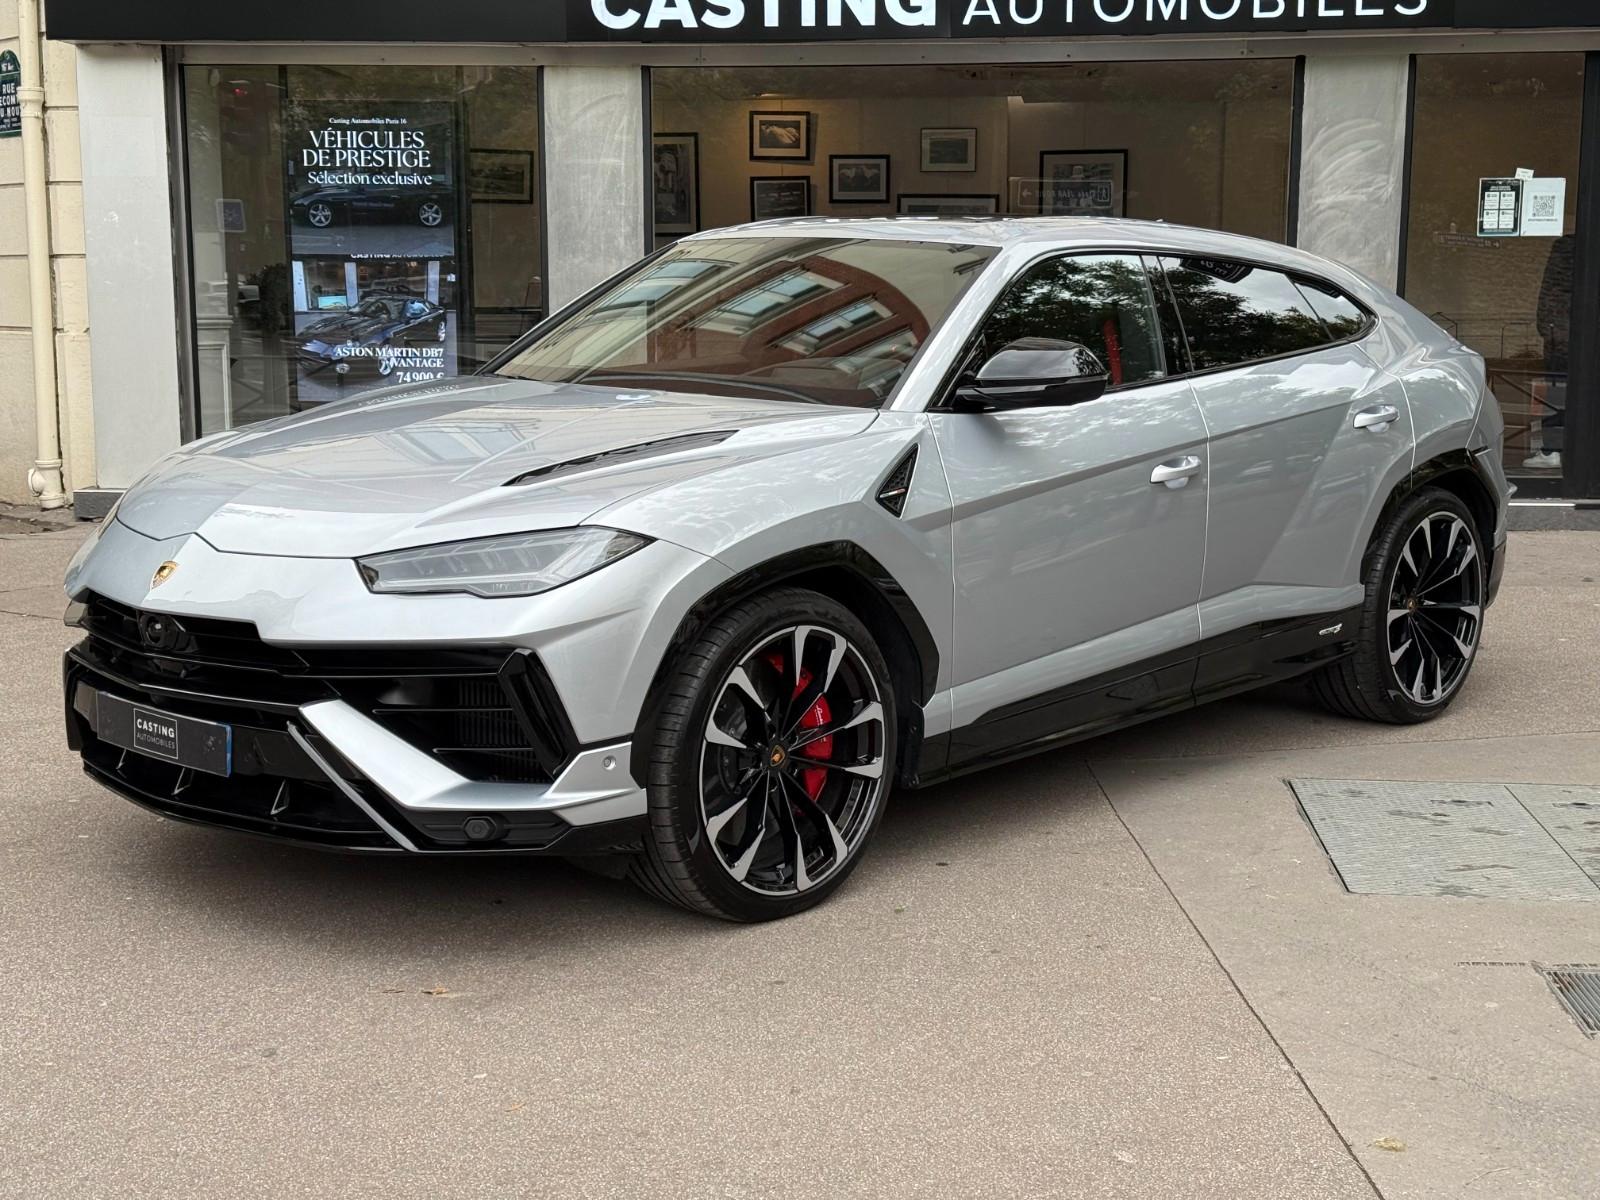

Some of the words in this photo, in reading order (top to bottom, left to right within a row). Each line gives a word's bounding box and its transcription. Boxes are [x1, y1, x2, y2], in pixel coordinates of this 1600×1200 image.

[590, 0, 937, 30] CASTING
[2, 83, 15, 94] RUE
[329, 117, 350, 125] Casting
[309, 127, 425, 149] VÉHICULES
[303, 149, 331, 167] DE
[335, 149, 431, 168] PRESTIGE
[308, 170, 370, 185] Sélection
[372, 171, 433, 185] exclusive
[335, 347, 375, 357] ASTON
[375, 347, 420, 357] MARTIN
[422, 348, 444, 357] DB7
[391, 358, 445, 368] VANTAGE
[136, 718, 175, 738] CASTING
[136, 732, 175, 749] AUTOMOBILES
